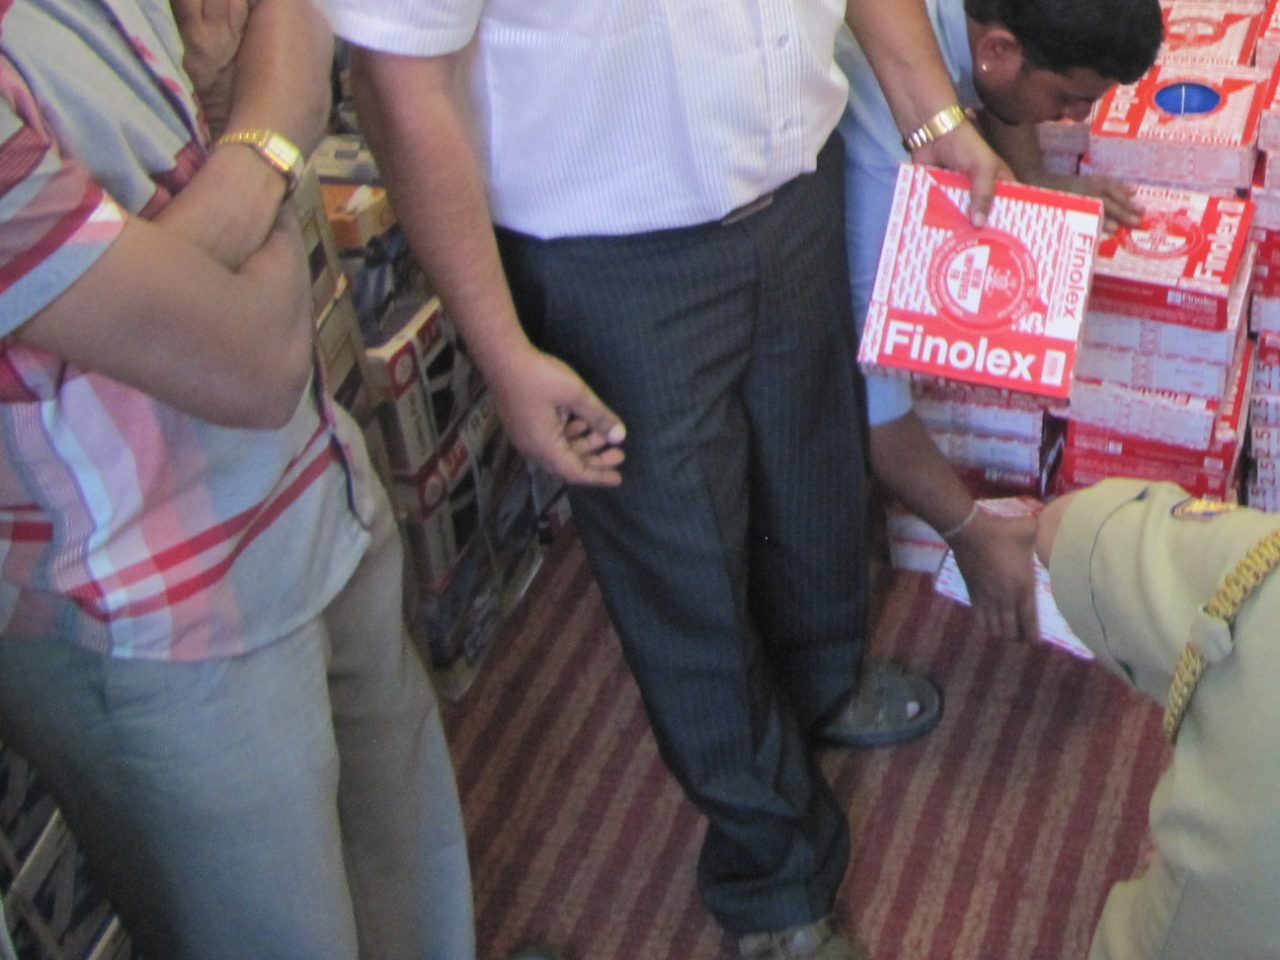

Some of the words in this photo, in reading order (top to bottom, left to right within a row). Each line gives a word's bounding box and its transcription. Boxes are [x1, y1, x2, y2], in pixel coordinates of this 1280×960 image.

[1062, 231, 1096, 320] Finolex
[1193, 212, 1243, 280] Finolex
[884, 320, 1037, 382] Finolex
